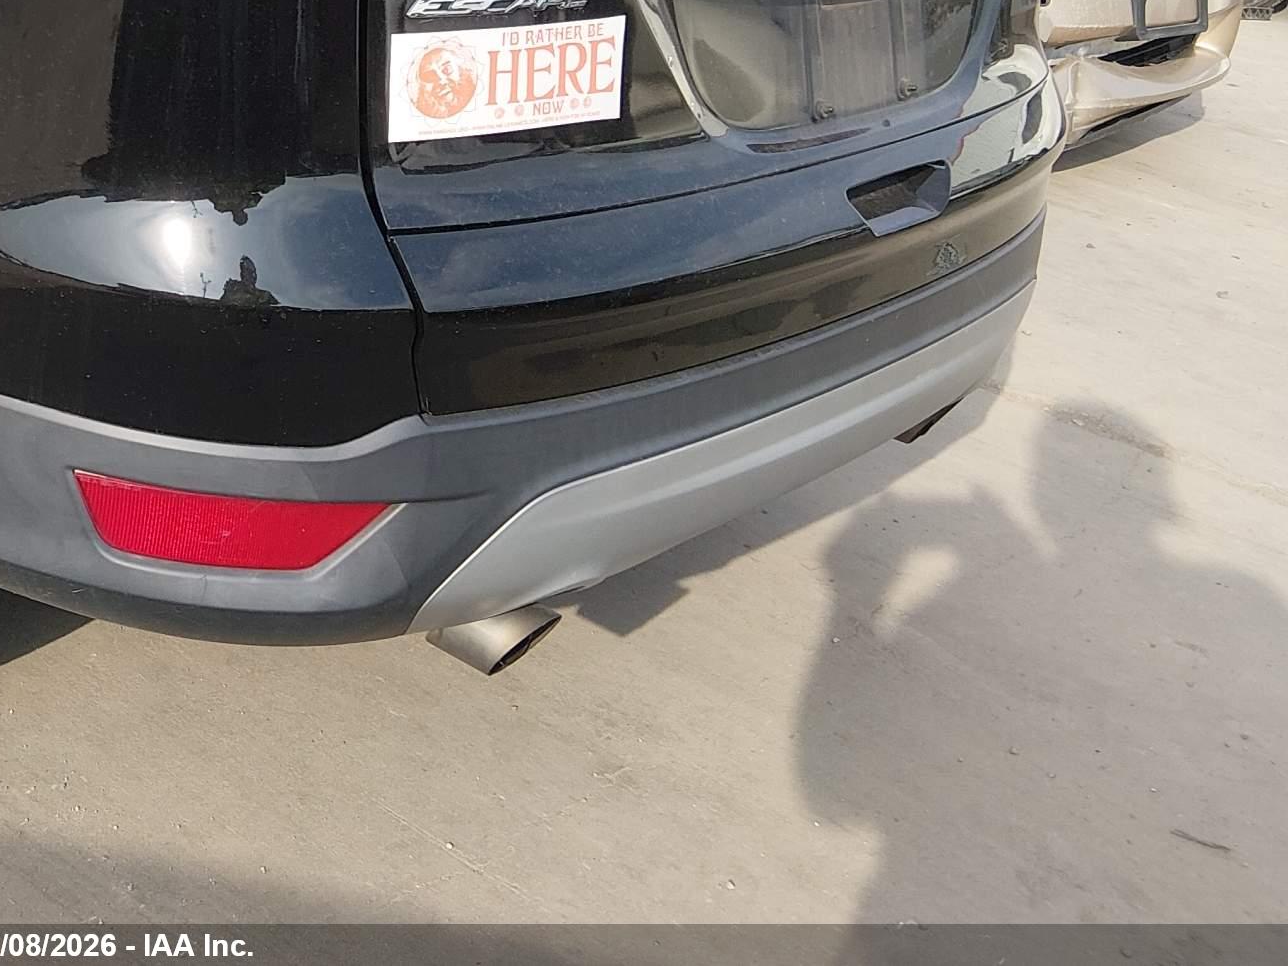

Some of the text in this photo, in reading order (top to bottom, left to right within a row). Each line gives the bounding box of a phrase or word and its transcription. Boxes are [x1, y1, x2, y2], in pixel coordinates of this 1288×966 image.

[502, 23, 604, 46] I'D RATHER BE
[485, 36, 616, 106] HERE
[533, 101, 565, 116] NOW
